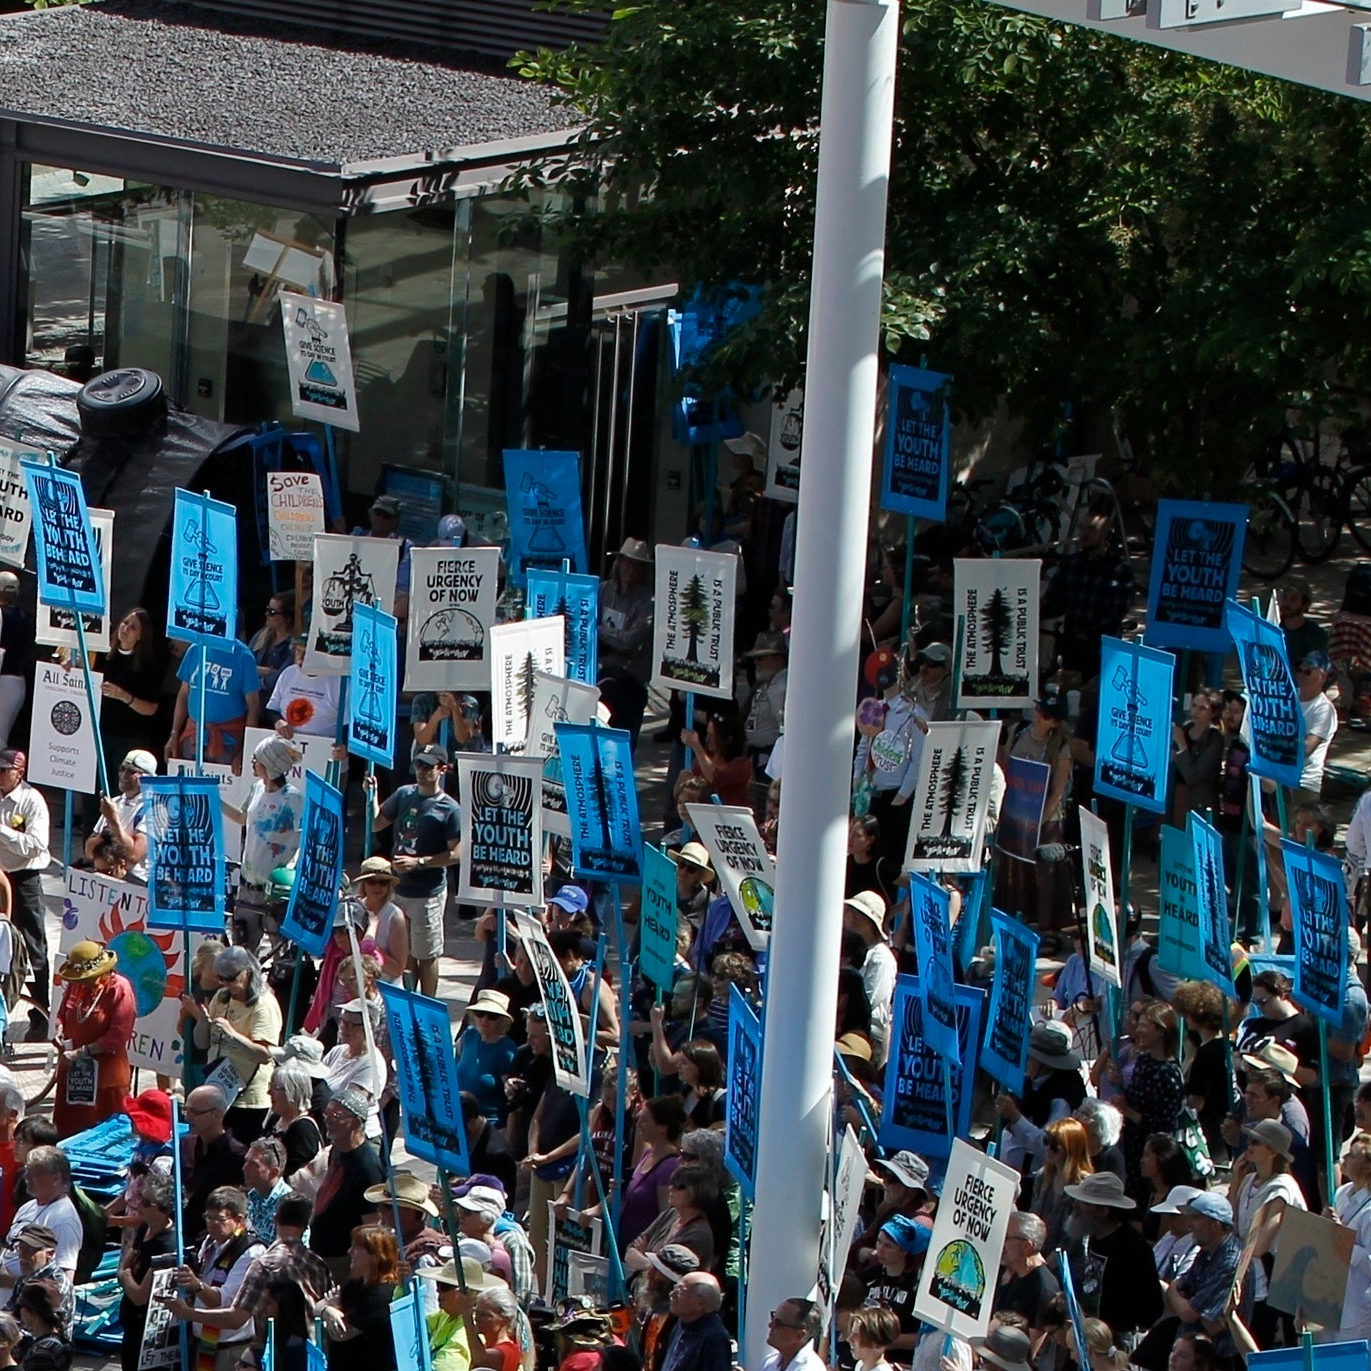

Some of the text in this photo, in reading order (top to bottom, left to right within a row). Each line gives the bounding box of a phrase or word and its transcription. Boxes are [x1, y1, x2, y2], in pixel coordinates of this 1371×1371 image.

[269, 474, 309, 492] Save
[437, 560, 476, 573] FIERCE
[1174, 547, 1223, 566] LET THE
[426, 574, 484, 588] URGENCY
[1167, 565, 1224, 588] YOUTH
[429, 589, 479, 603] OF NOW
[1161, 583, 1223, 603] BE HEARD
[666, 569, 679, 649] THE ATMOSPHERE
[709, 578, 723, 661] IS A PUBLIC TRUST
[966, 588, 978, 669] THE ATMOSPHERE
[1015, 587, 1027, 669] IS A PUBLIC TRUST
[42, 670, 60, 685] All
[48, 742, 79, 756] Supports
[49, 754, 76, 767] Climate
[50, 766, 75, 779] Justice
[478, 806, 524, 824] LET THE
[474, 823, 528, 849] YOUTH
[473, 844, 531, 866] BE HEARD
[69, 875, 131, 912] LISTEN
[964, 1173, 995, 1204] FIERCE
[954, 1187, 997, 1224] URGENCY
[952, 1209, 992, 1243] OF NOW
